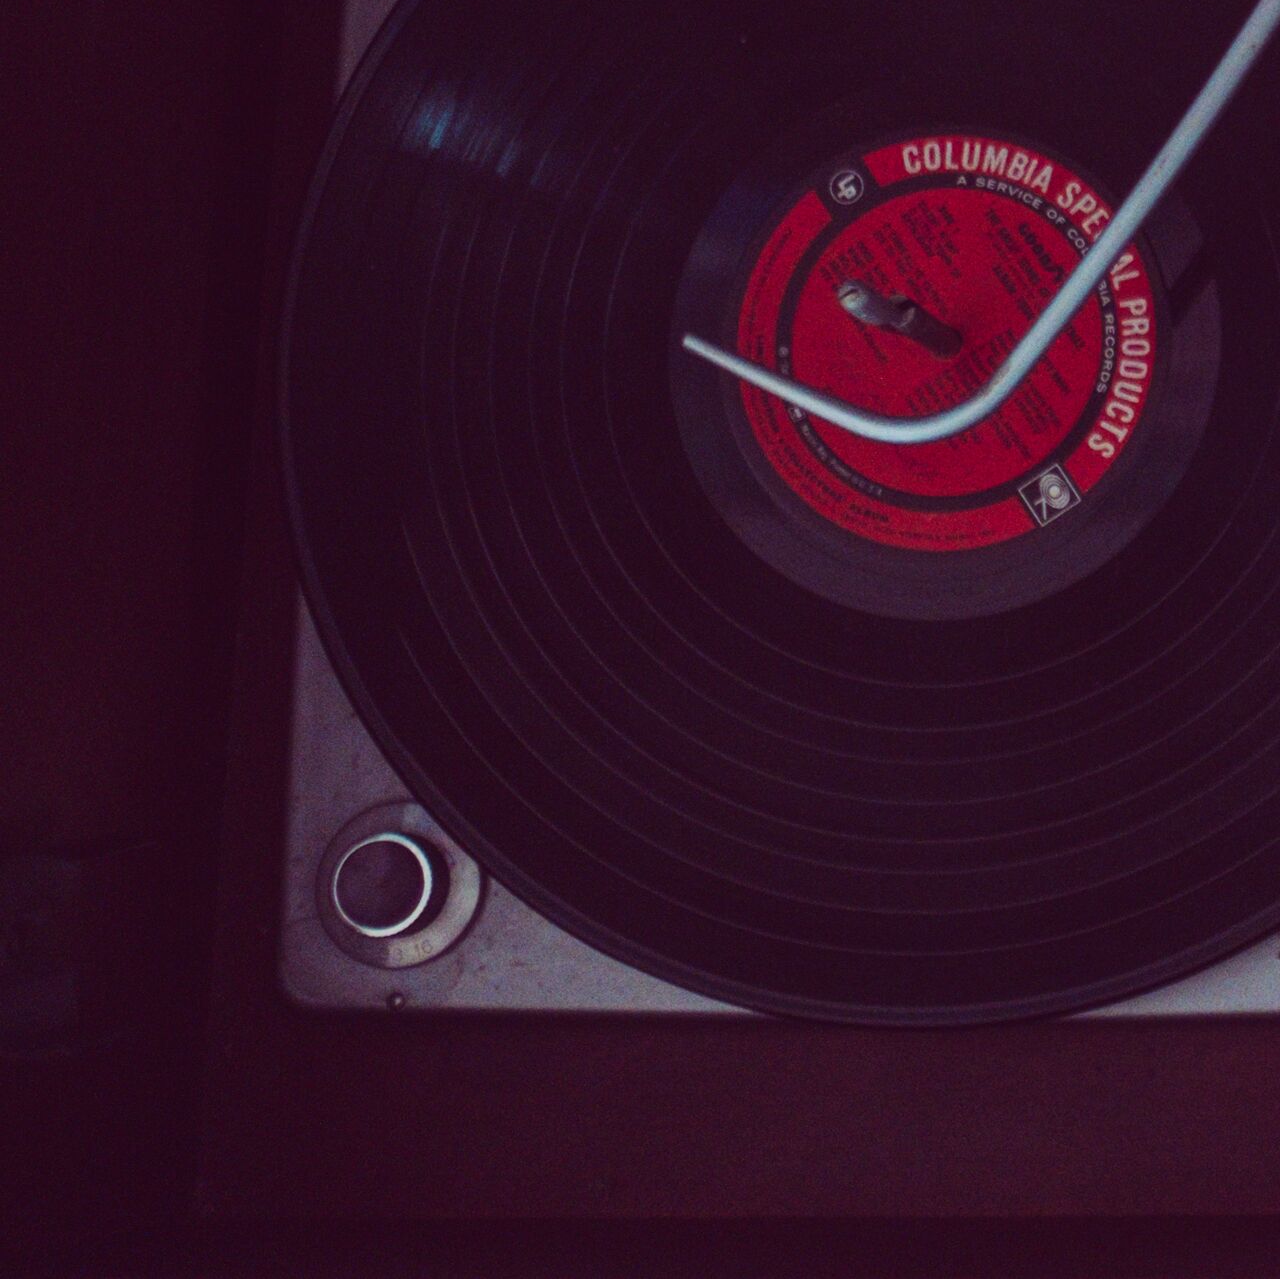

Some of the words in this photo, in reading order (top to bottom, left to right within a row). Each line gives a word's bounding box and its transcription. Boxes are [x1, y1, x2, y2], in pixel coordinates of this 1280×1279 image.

[902, 140, 1054, 194] COLUMBIA
[955, 175, 968, 187] A
[975, 176, 1043, 210] SERVICE
[1046, 208, 1066, 226] OF
[1066, 227, 1111, 307] COLBIA
[1096, 313, 1116, 394] RECORDS
[1056, 181, 1141, 291] SPEAL
[1087, 298, 1151, 459] PRODUCTS
